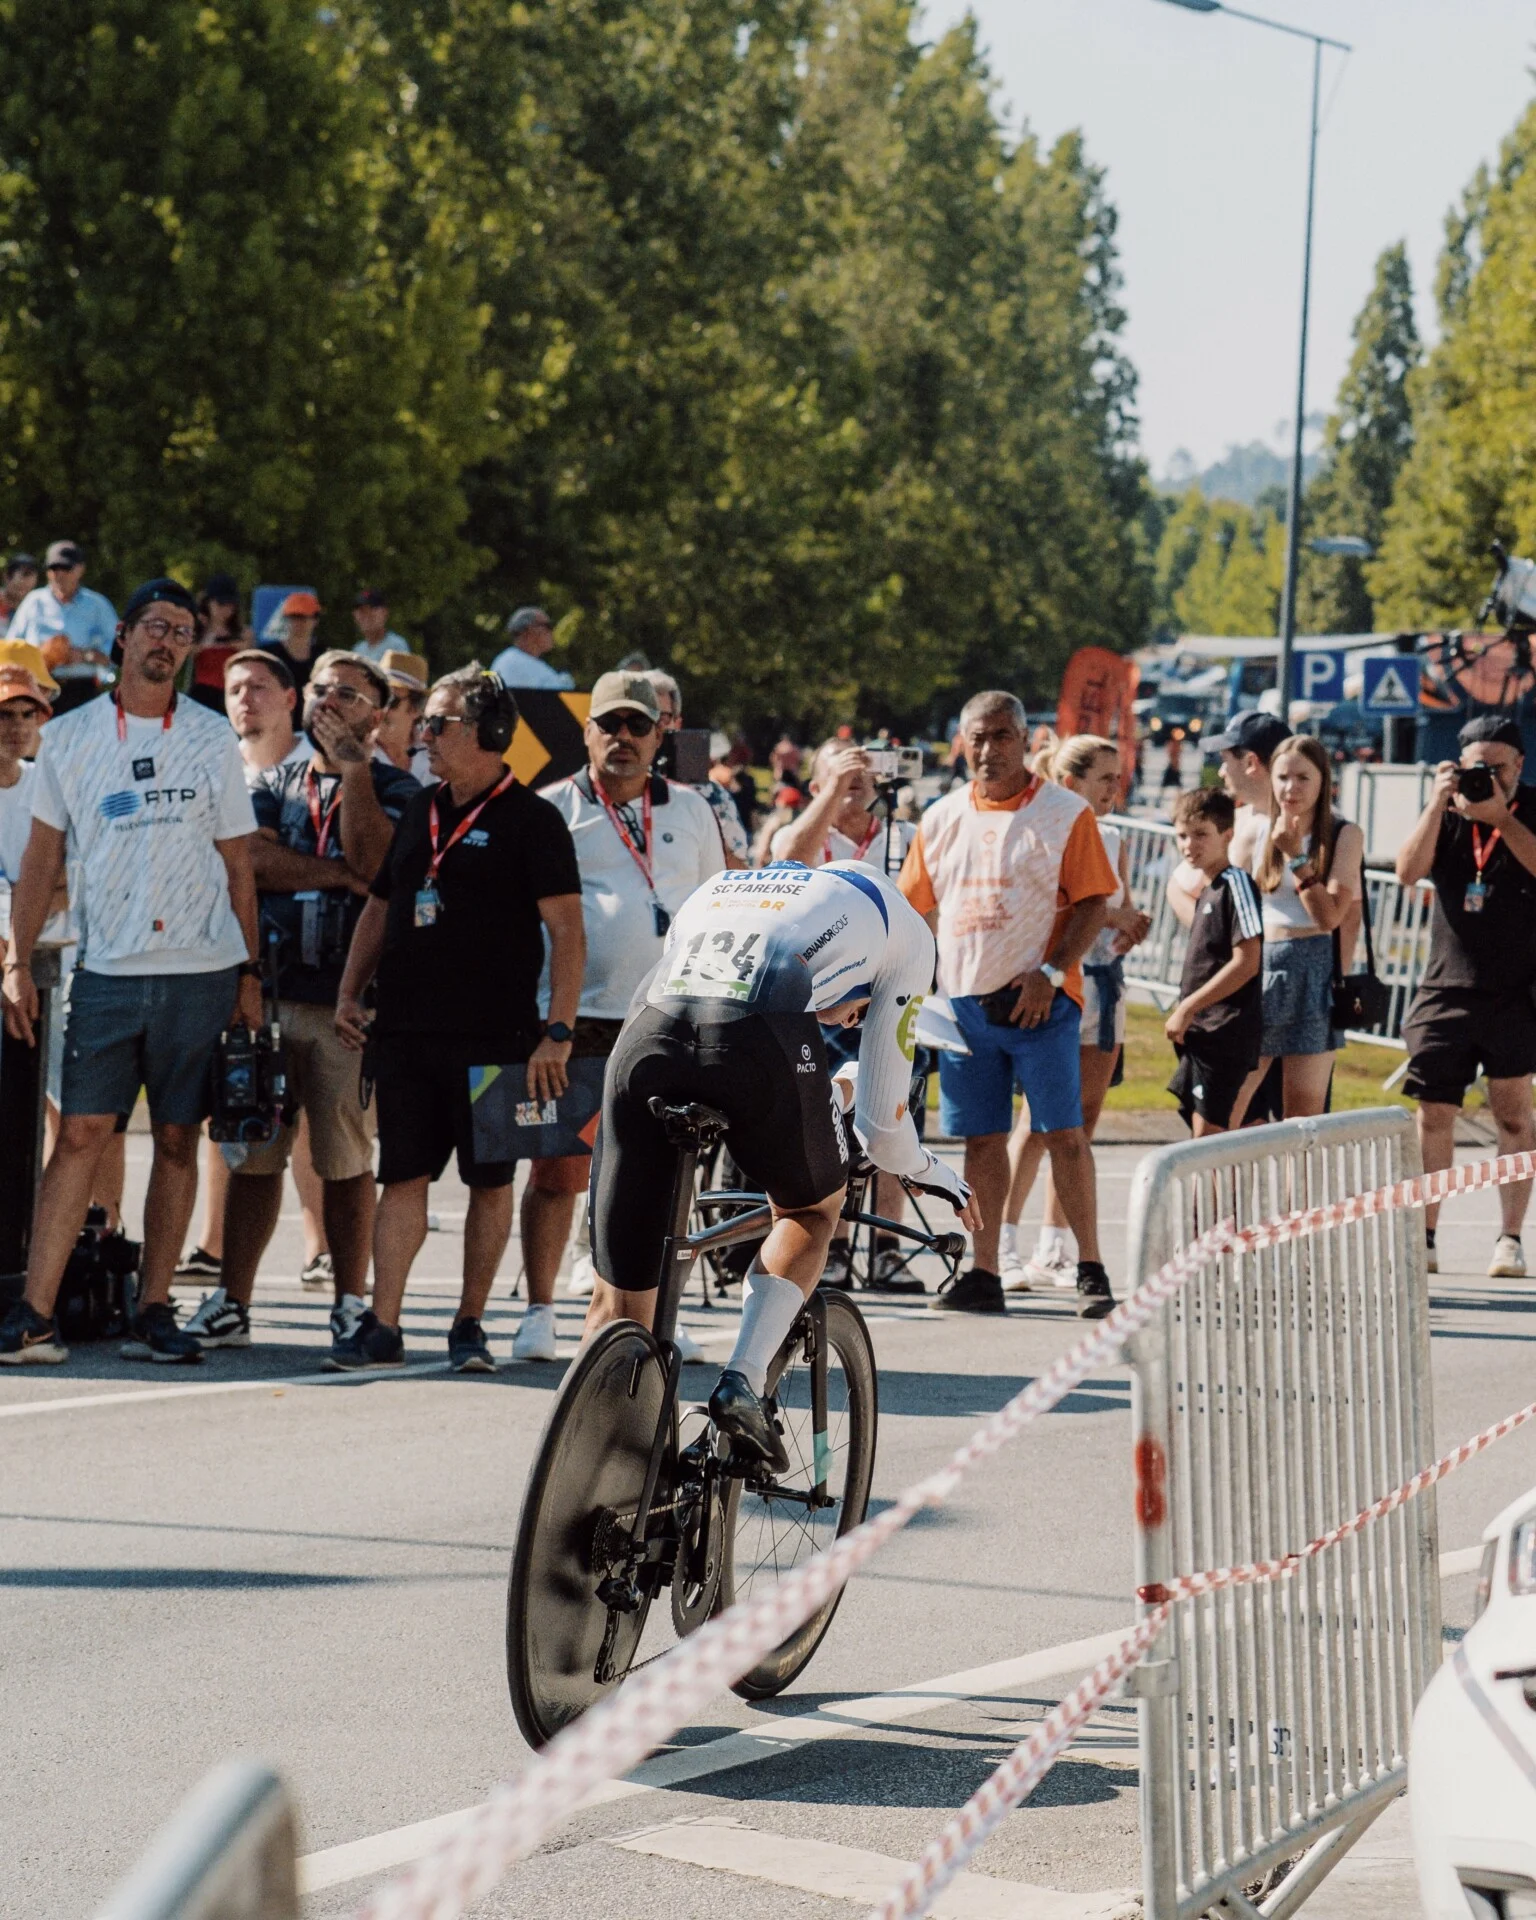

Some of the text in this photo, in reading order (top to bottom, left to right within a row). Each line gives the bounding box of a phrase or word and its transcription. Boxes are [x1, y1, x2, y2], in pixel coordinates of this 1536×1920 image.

[1303, 653, 1336, 699] P
[144, 788, 196, 804] RTP
[722, 869, 815, 882] tavira
[712, 883, 807, 896] SC FARENSE
[803, 914, 848, 961] BENAMORGOLF
[797, 1063, 816, 1073] PACTO
